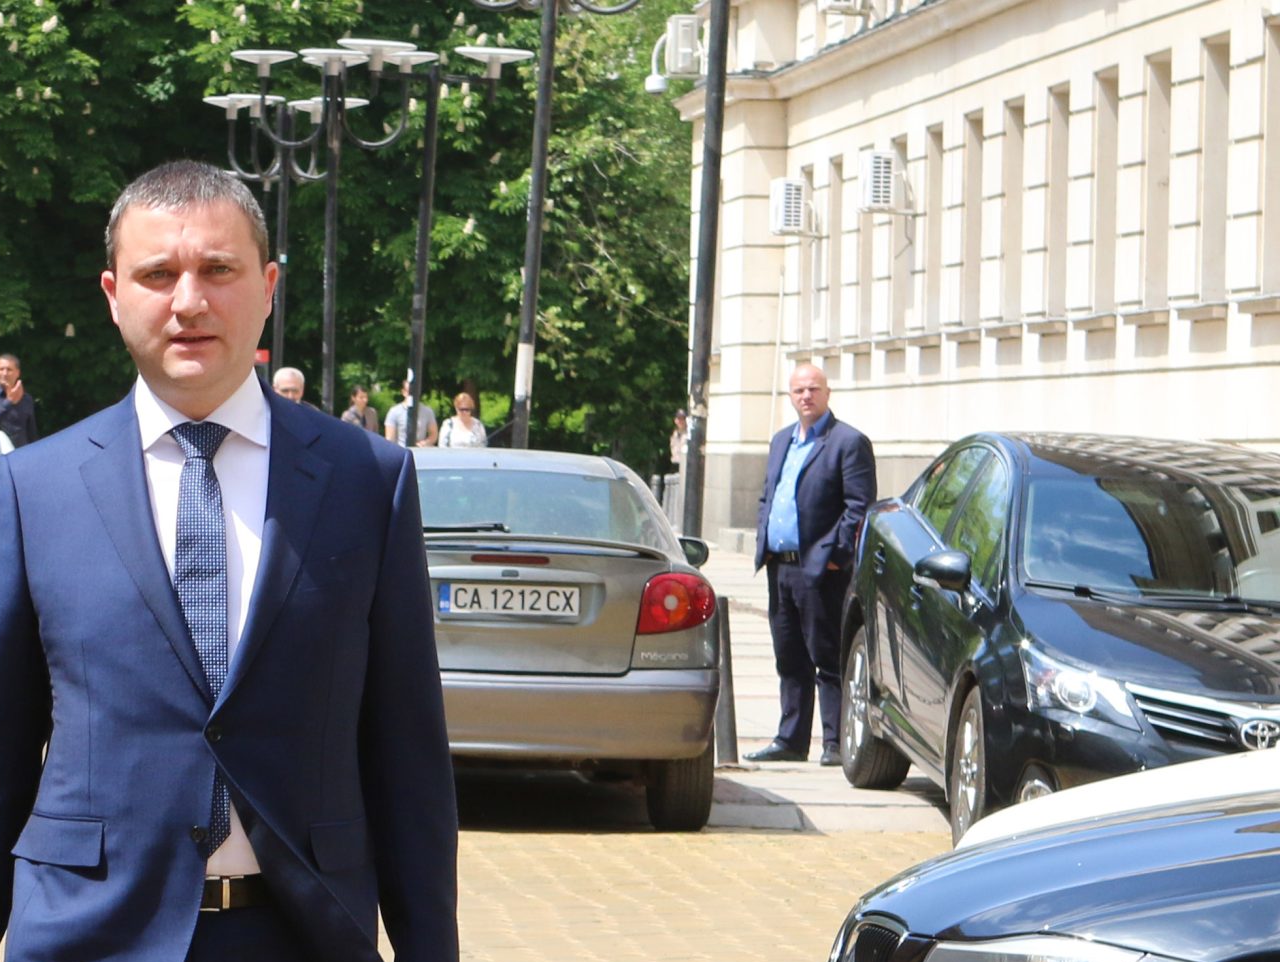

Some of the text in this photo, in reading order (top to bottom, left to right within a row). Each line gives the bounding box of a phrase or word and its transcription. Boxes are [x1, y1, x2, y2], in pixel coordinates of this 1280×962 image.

[454, 587, 482, 609] CA
[491, 588, 542, 611] 1212
[546, 590, 575, 612] CX
